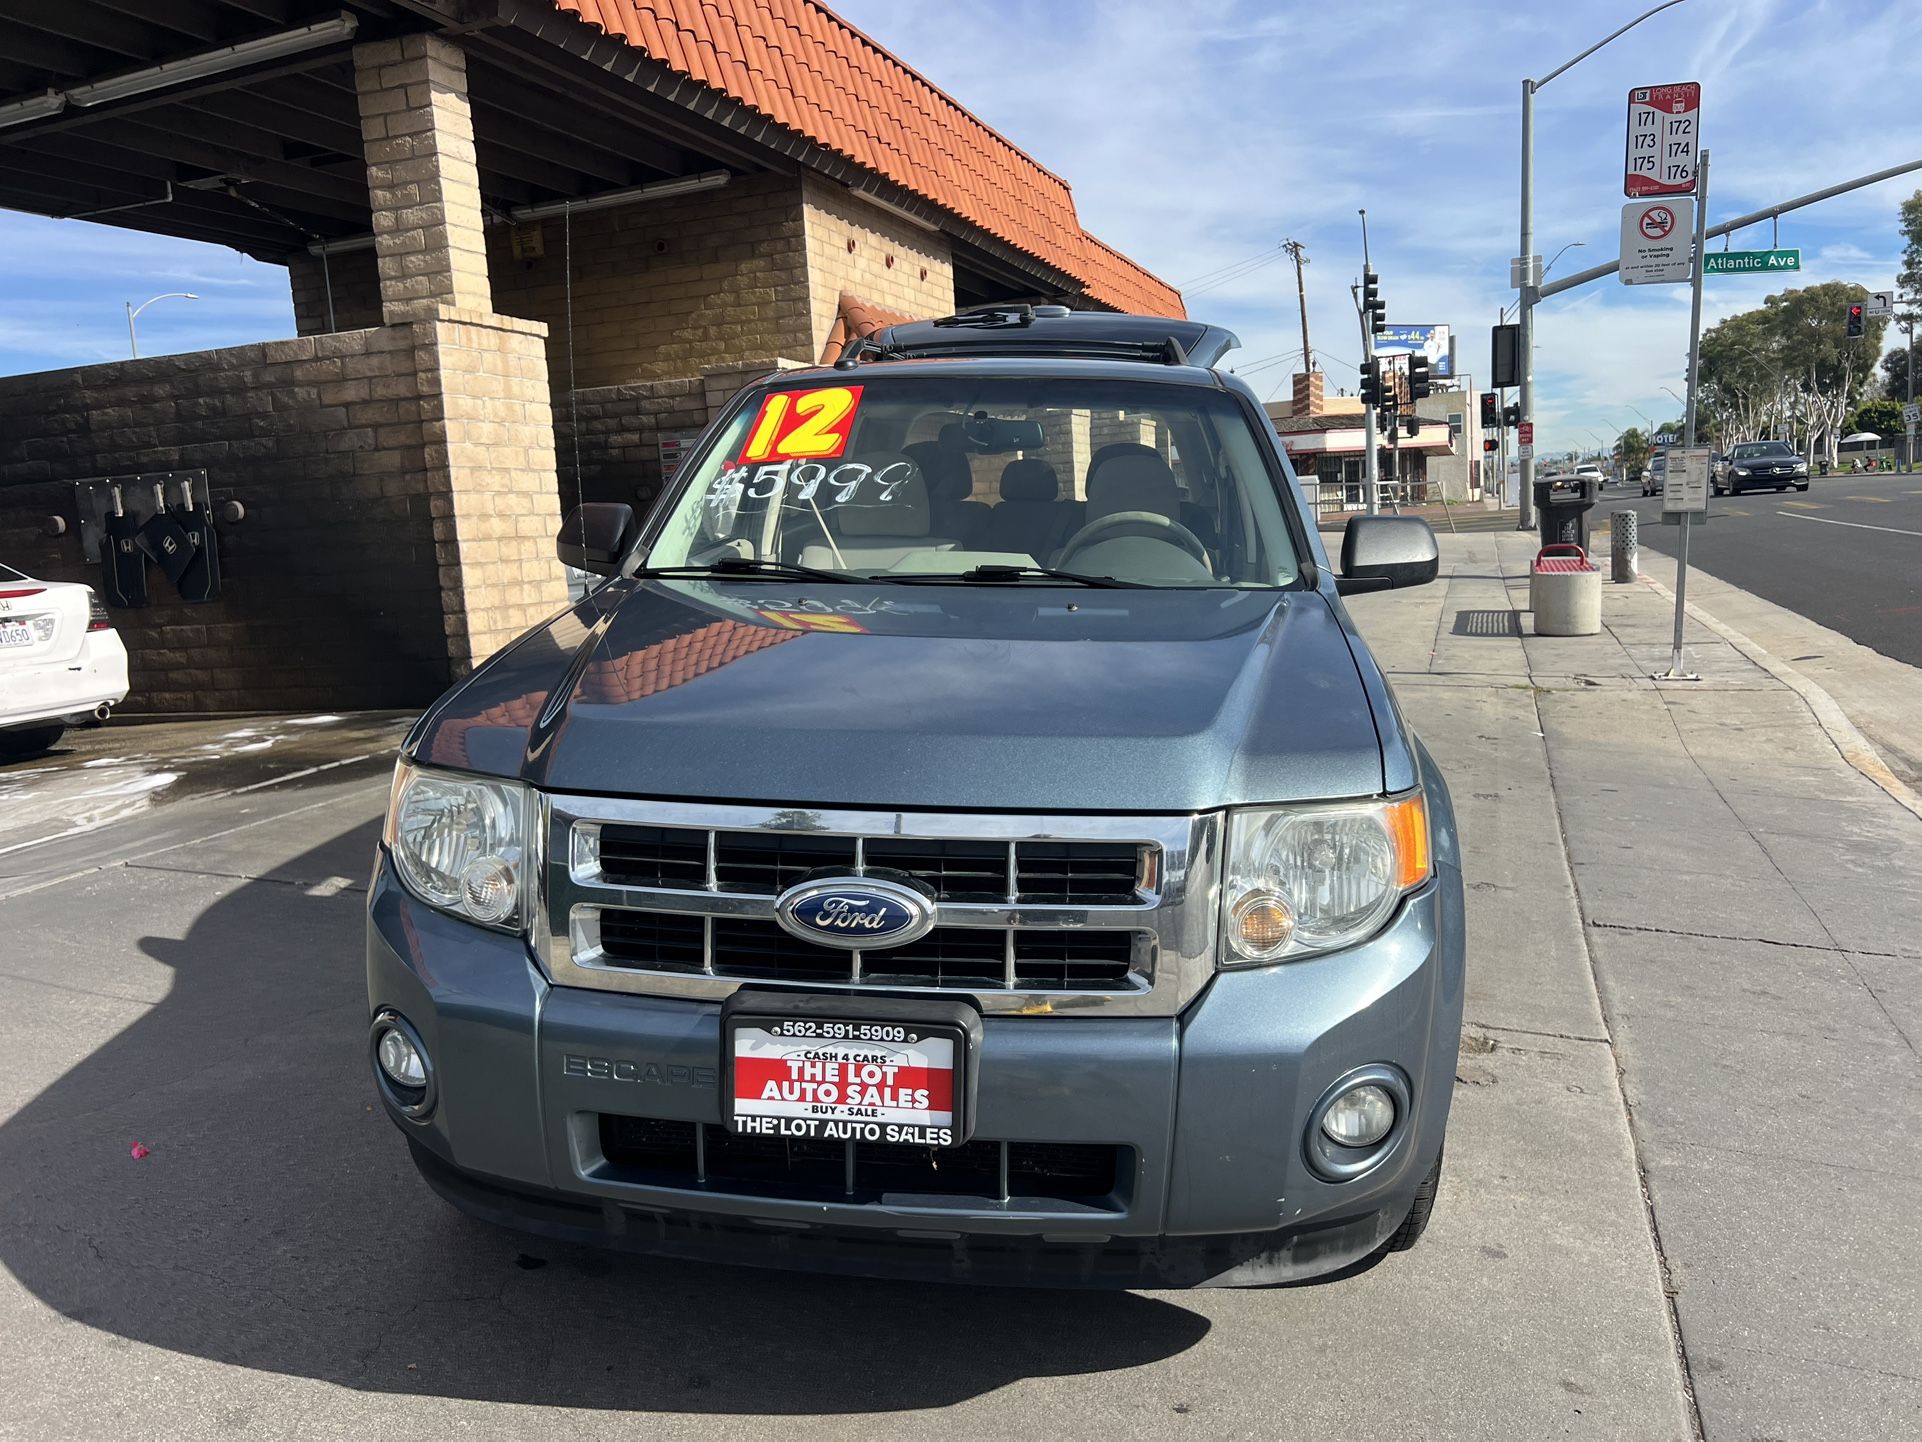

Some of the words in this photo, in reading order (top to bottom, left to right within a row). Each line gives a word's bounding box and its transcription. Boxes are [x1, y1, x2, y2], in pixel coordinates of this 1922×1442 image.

[1653, 86, 1672, 95] LONG
[1673, 83, 1696, 92] BEACH
[1653, 91, 1696, 101] TRANSIT
[1638, 111, 1656, 127] 171
[1669, 119, 1692, 136] 172
[1634, 133, 1656, 150] 173
[1668, 141, 1690, 158] 174
[1633, 155, 1655, 172] 175
[1667, 164, 1689, 180] 176
[1707, 256, 1762, 270] Atlantic
[1767, 255, 1795, 267] Ave
[745, 387, 855, 461] 12
[1905, 412, 1919, 422] 35
[0, 628, 30, 643] D650
[815, 897, 887, 929] Ford
[782, 1020, 906, 1042] 562-591-5909
[803, 1050, 839, 1062] CASH
[841, 1052, 850, 1062] 4
[852, 1053, 887, 1064] CARS
[563, 1053, 716, 1089] ESCAPE
[786, 1059, 839, 1083] THE
[847, 1062, 899, 1086] LOT
[760, 1079, 840, 1104] AUTO
[845, 1084, 931, 1110] SALES
[811, 1104, 838, 1115] BUY
[847, 1106, 879, 1118] SALE
[734, 1115, 774, 1134] THE
[780, 1118, 820, 1138] LOT
[823, 1121, 881, 1141] AUTO
[886, 1124, 953, 1147] SALES
